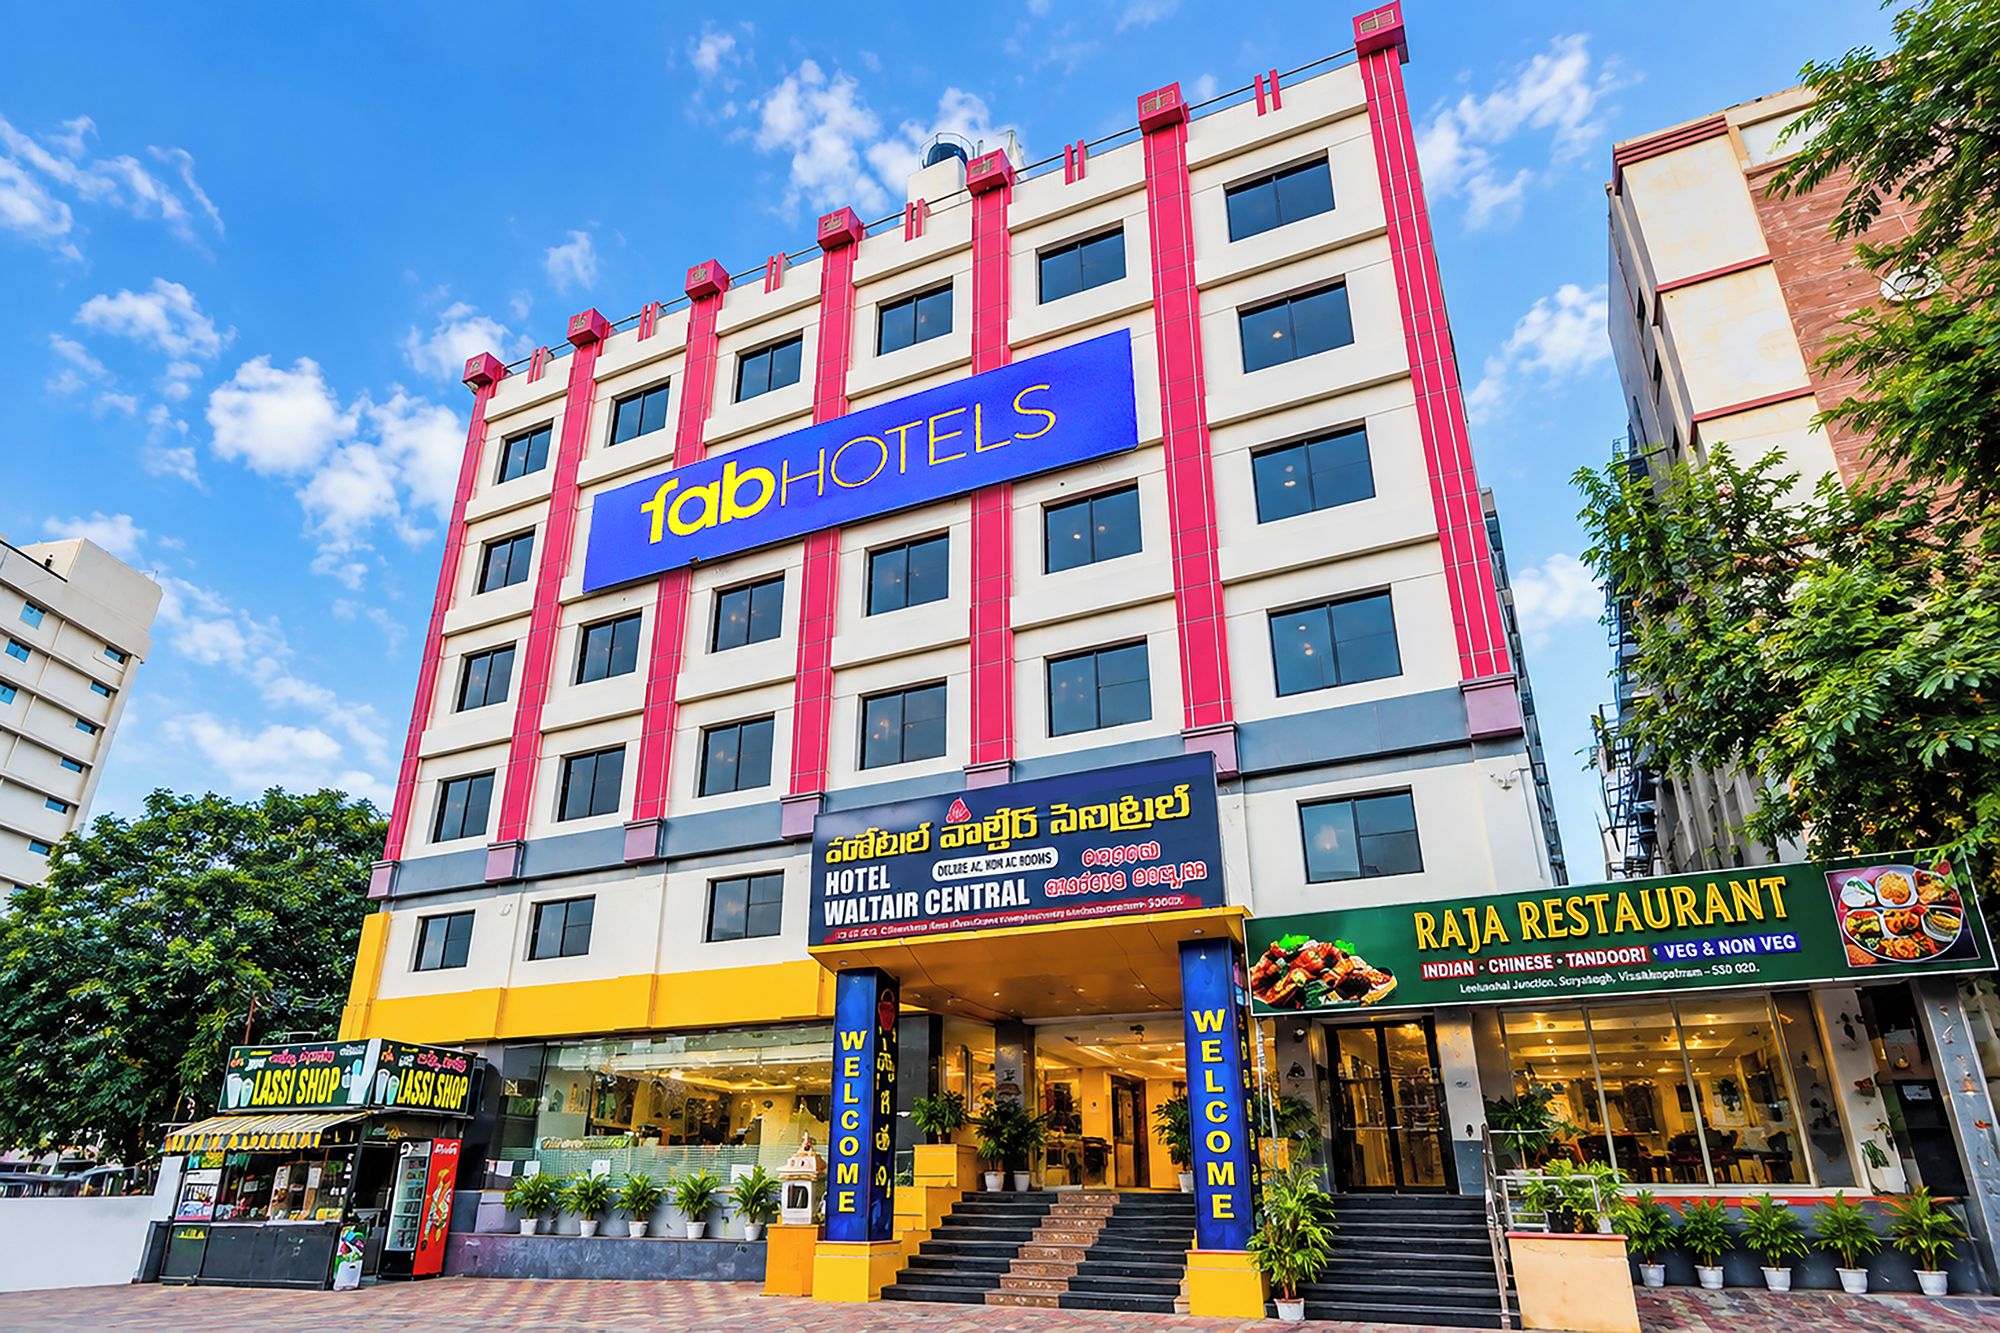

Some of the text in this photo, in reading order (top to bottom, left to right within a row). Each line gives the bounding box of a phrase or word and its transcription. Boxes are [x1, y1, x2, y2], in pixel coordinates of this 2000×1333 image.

[824, 891, 919, 926] WALTAIR
[924, 878, 1030, 915] CENTRAL
[825, 864, 891, 896] HOTEL
[1413, 876, 1788, 955] RAJA RESTAURANT
[1423, 934, 1797, 978] INDIAN CHINESE TANDOORI VEG & NON VEG
[251, 1066, 341, 1106] LASSI SHOP
[396, 1068, 468, 1110] LASSI SHOP
[836, 1029, 868, 1213] WELCOME
[1190, 1007, 1236, 1219] WELCOME
